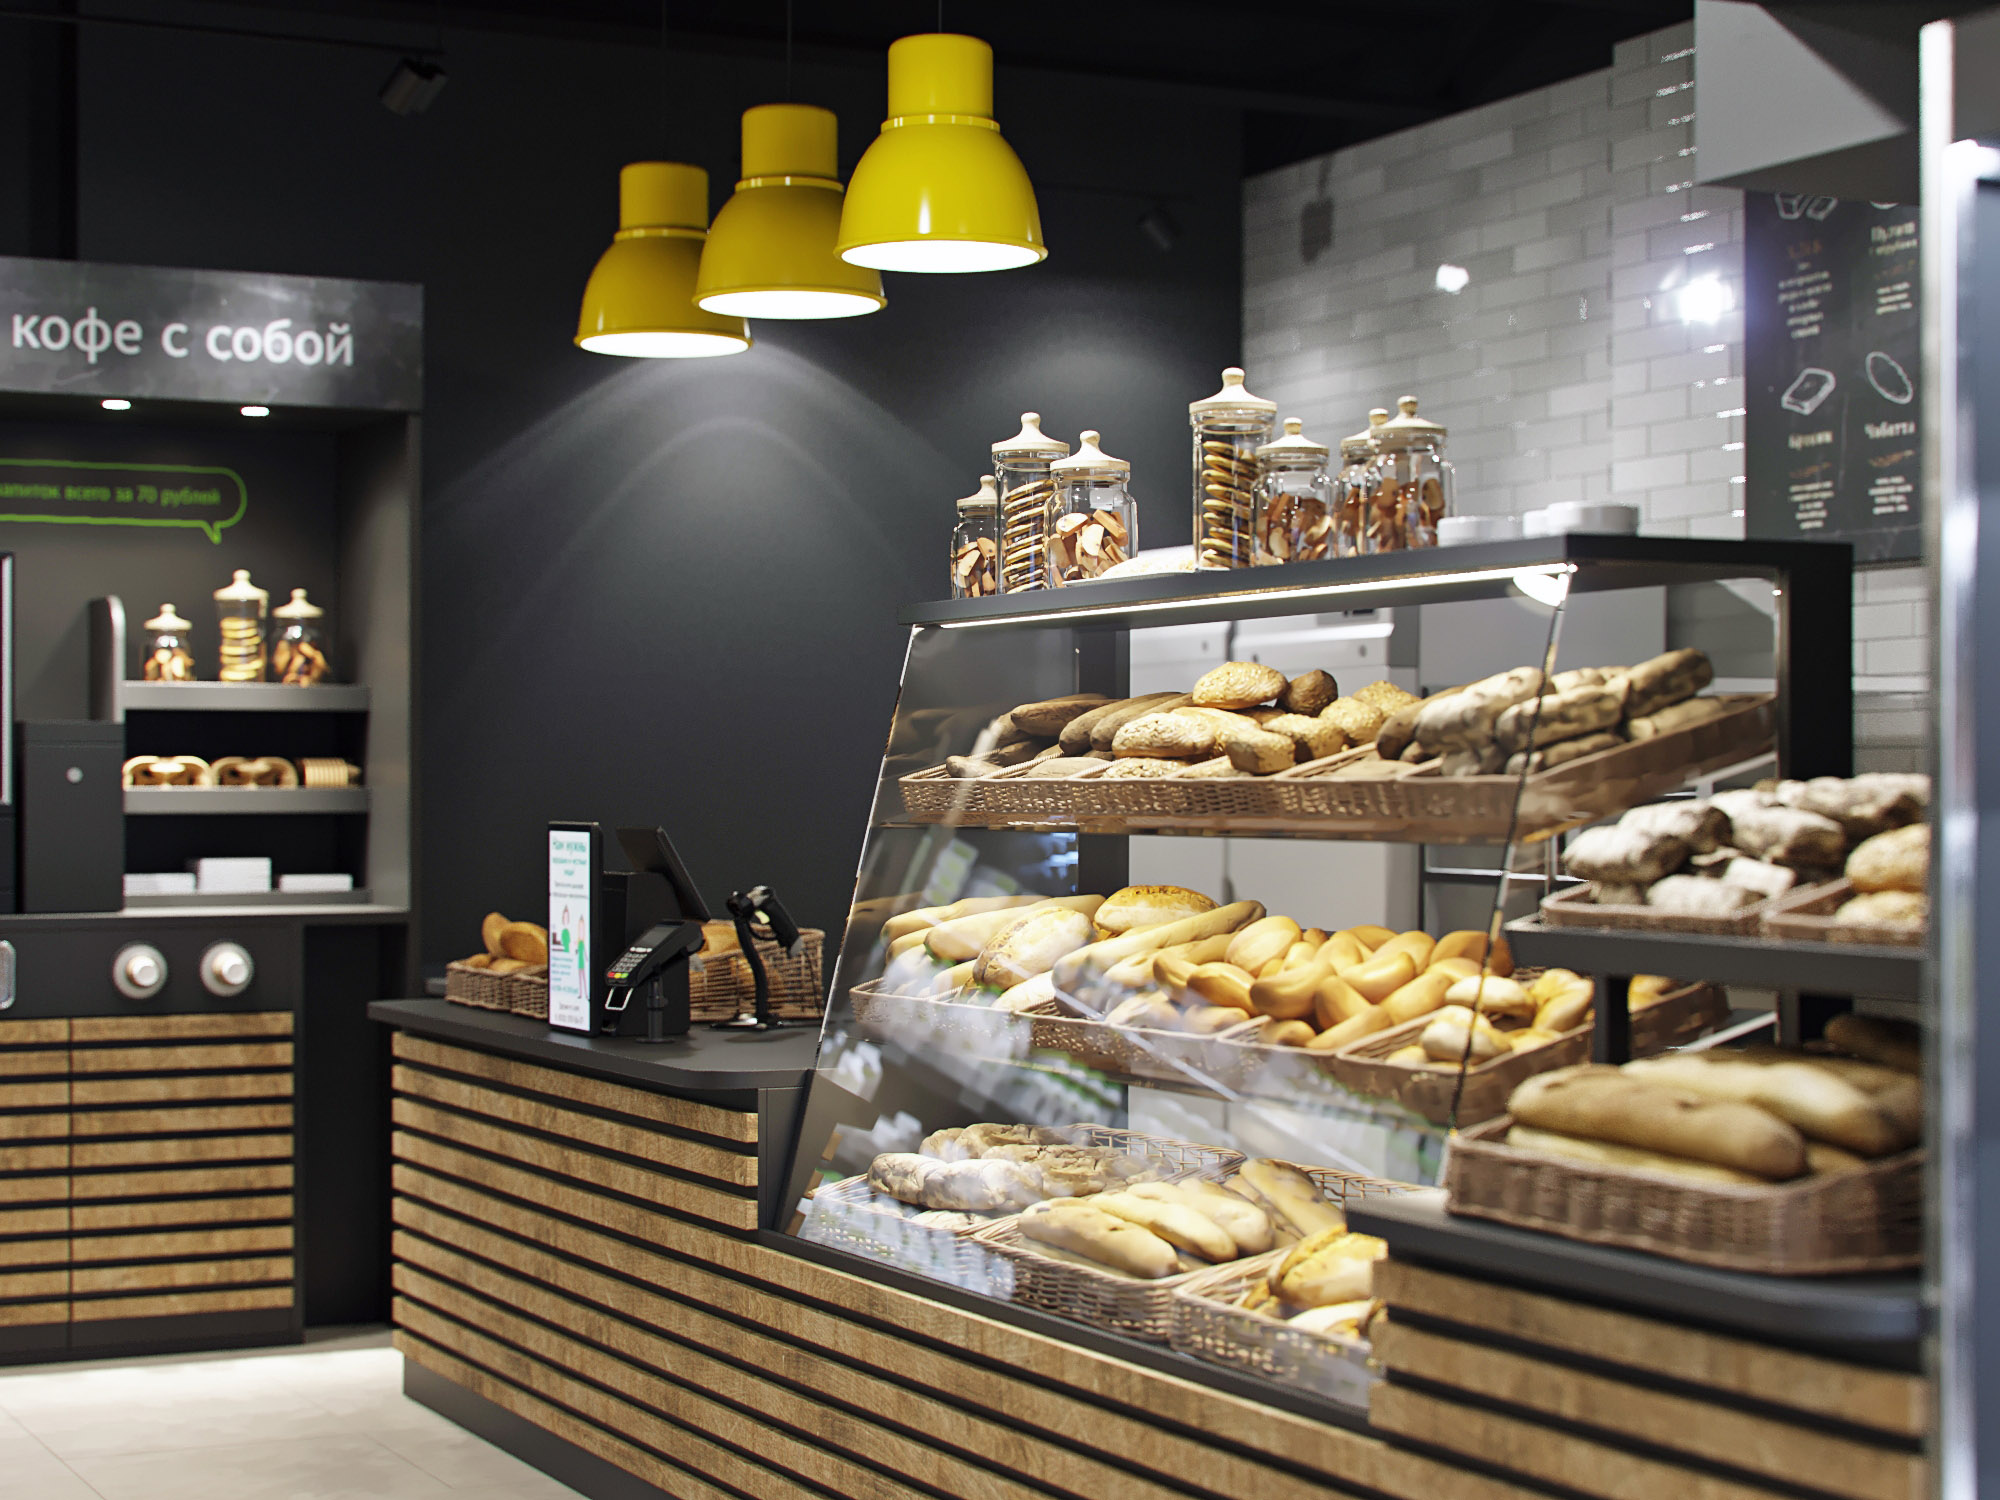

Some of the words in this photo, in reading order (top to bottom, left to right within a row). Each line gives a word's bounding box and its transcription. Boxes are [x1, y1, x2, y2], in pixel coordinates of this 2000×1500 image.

[12, 307, 143, 364] кофе
[161, 321, 189, 358] с
[205, 317, 355, 367] собой
[137, 484, 158, 505] 70
